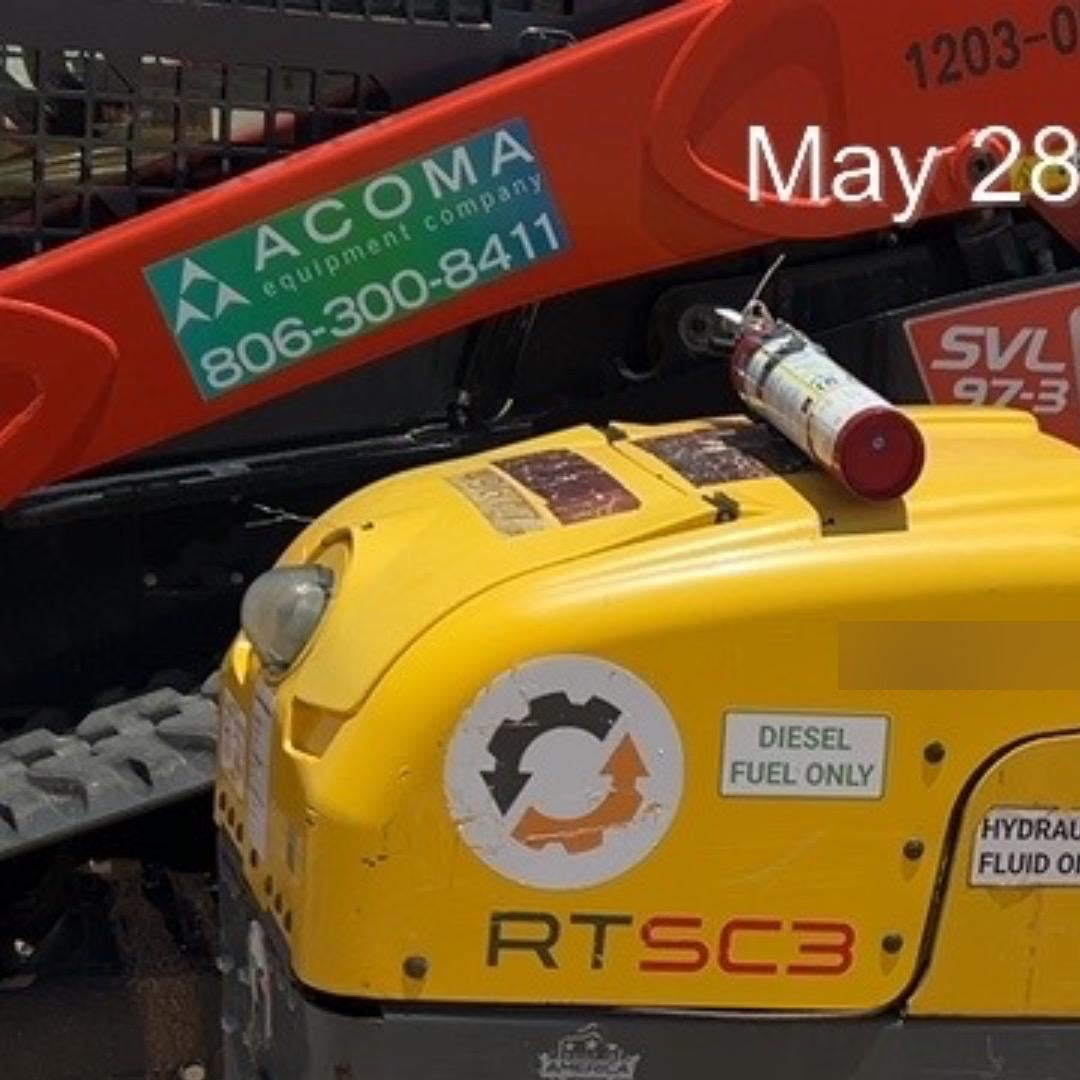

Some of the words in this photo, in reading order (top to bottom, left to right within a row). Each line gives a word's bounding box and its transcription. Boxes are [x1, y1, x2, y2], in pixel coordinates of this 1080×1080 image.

[253, 128, 536, 273] ACOMA
[261, 224, 412, 298] equipment
[424, 172, 544, 233] company
[200, 212, 560, 390] 806-300-8411
[930, 325, 1067, 373] SVL
[952, 376, 1070, 415] 97-3
[758, 725, 853, 751] DIESEL
[730, 761, 797, 785] FUEL
[805, 761, 875, 787] ONLY
[978, 851, 1050, 875] FLUID
